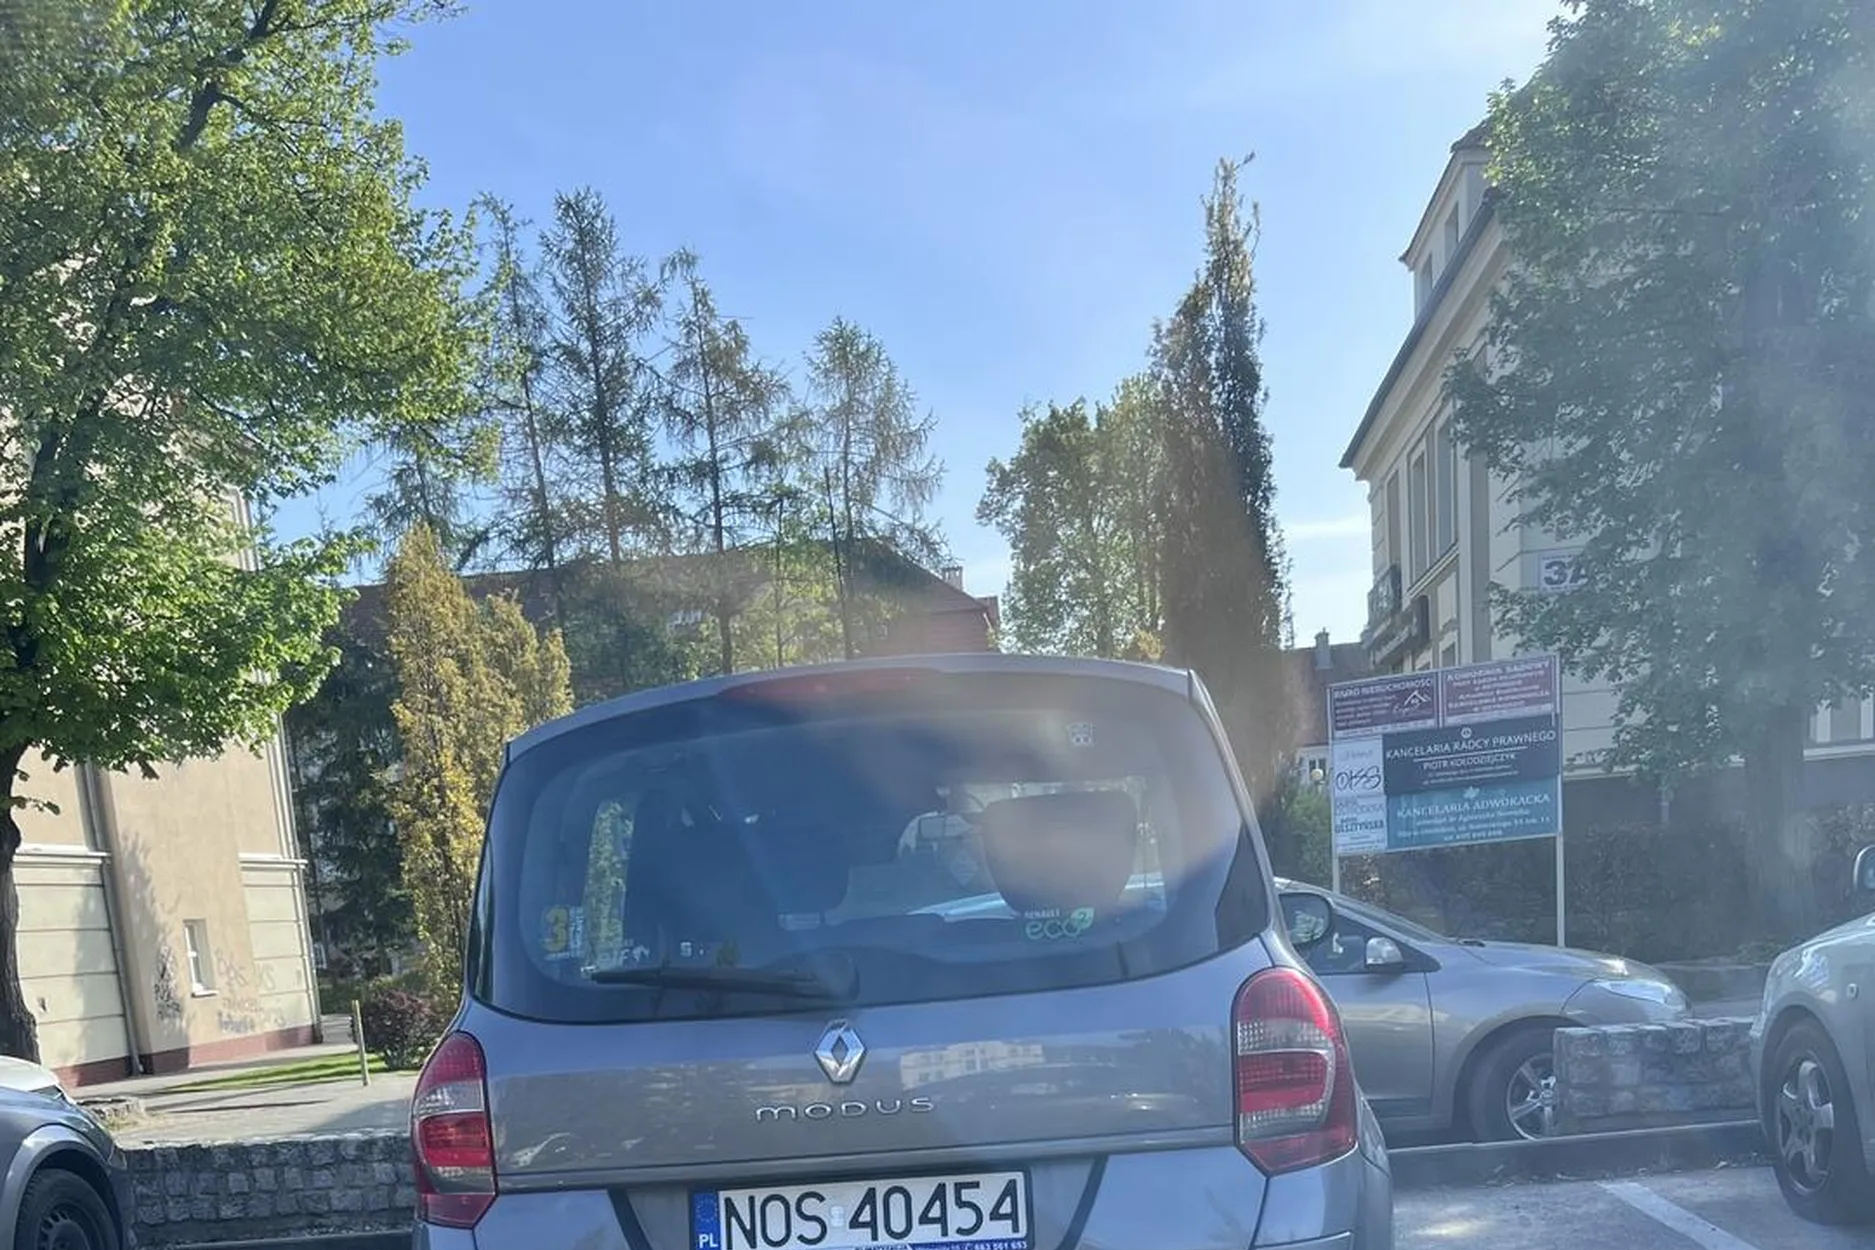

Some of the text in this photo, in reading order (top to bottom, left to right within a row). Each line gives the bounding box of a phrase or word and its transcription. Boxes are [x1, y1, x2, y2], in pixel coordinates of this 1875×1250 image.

[1386, 743, 1452, 759] KANCELARIA
[1453, 739, 1490, 753] RADCY
[1492, 729, 1557, 748] PRAWNEGO
[1423, 759, 1449, 770] PIOTR
[1397, 800, 1471, 819] KANCELARIA
[1472, 792, 1552, 811] ADWOKACKA
[848, 1178, 1021, 1243] 40454
[698, 1233, 719, 1249] PL
